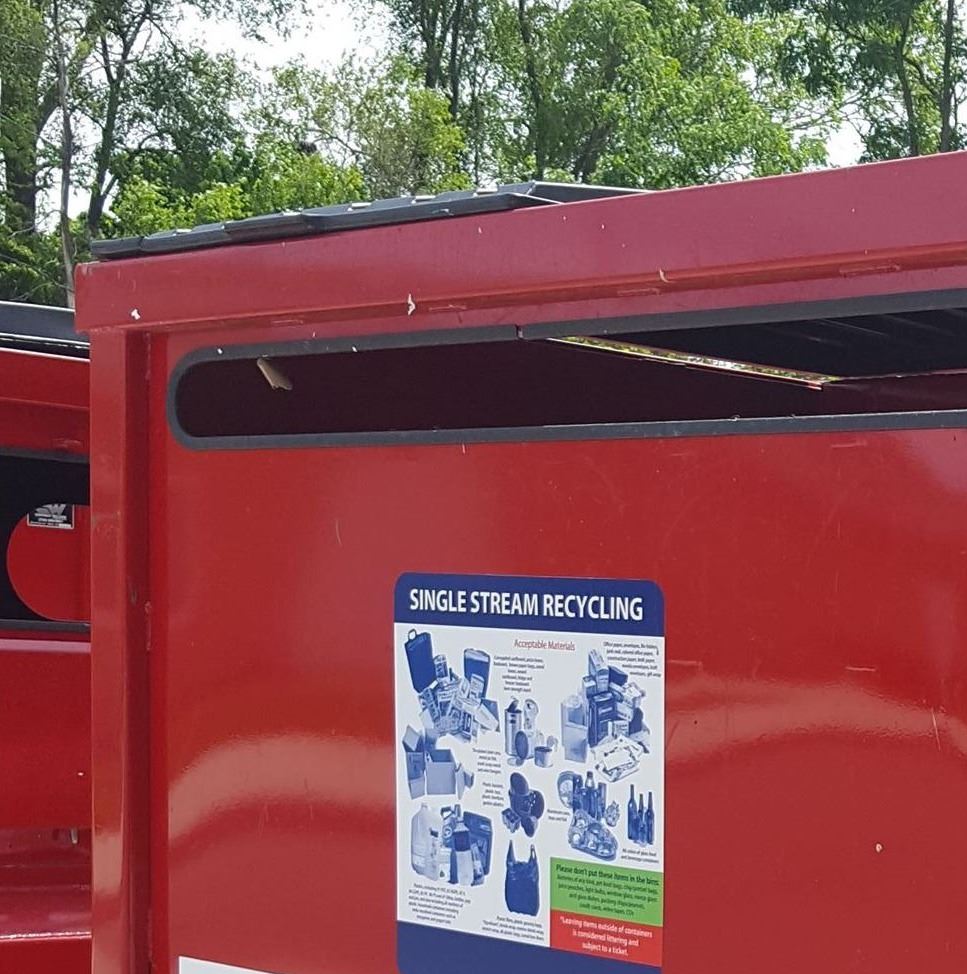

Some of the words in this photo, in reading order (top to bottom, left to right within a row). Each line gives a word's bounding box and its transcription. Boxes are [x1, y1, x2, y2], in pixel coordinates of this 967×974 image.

[410, 588, 467, 612] SINGLE
[470, 591, 539, 617] STREAM
[543, 595, 644, 621] RECYCLING
[514, 639, 547, 650] Acceptable
[548, 641, 576, 652] Materials
[556, 863, 573, 873] Please
[574, 867, 587, 877] don't
[598, 871, 613, 880] these
[613, 873, 629, 882] items
[636, 876, 645, 885] the
[577, 930, 606, 942] considered
[628, 939, 639, 947] and
[598, 922, 618, 933] outside
[625, 927, 653, 939] containers
[582, 941, 601, 952] subject
